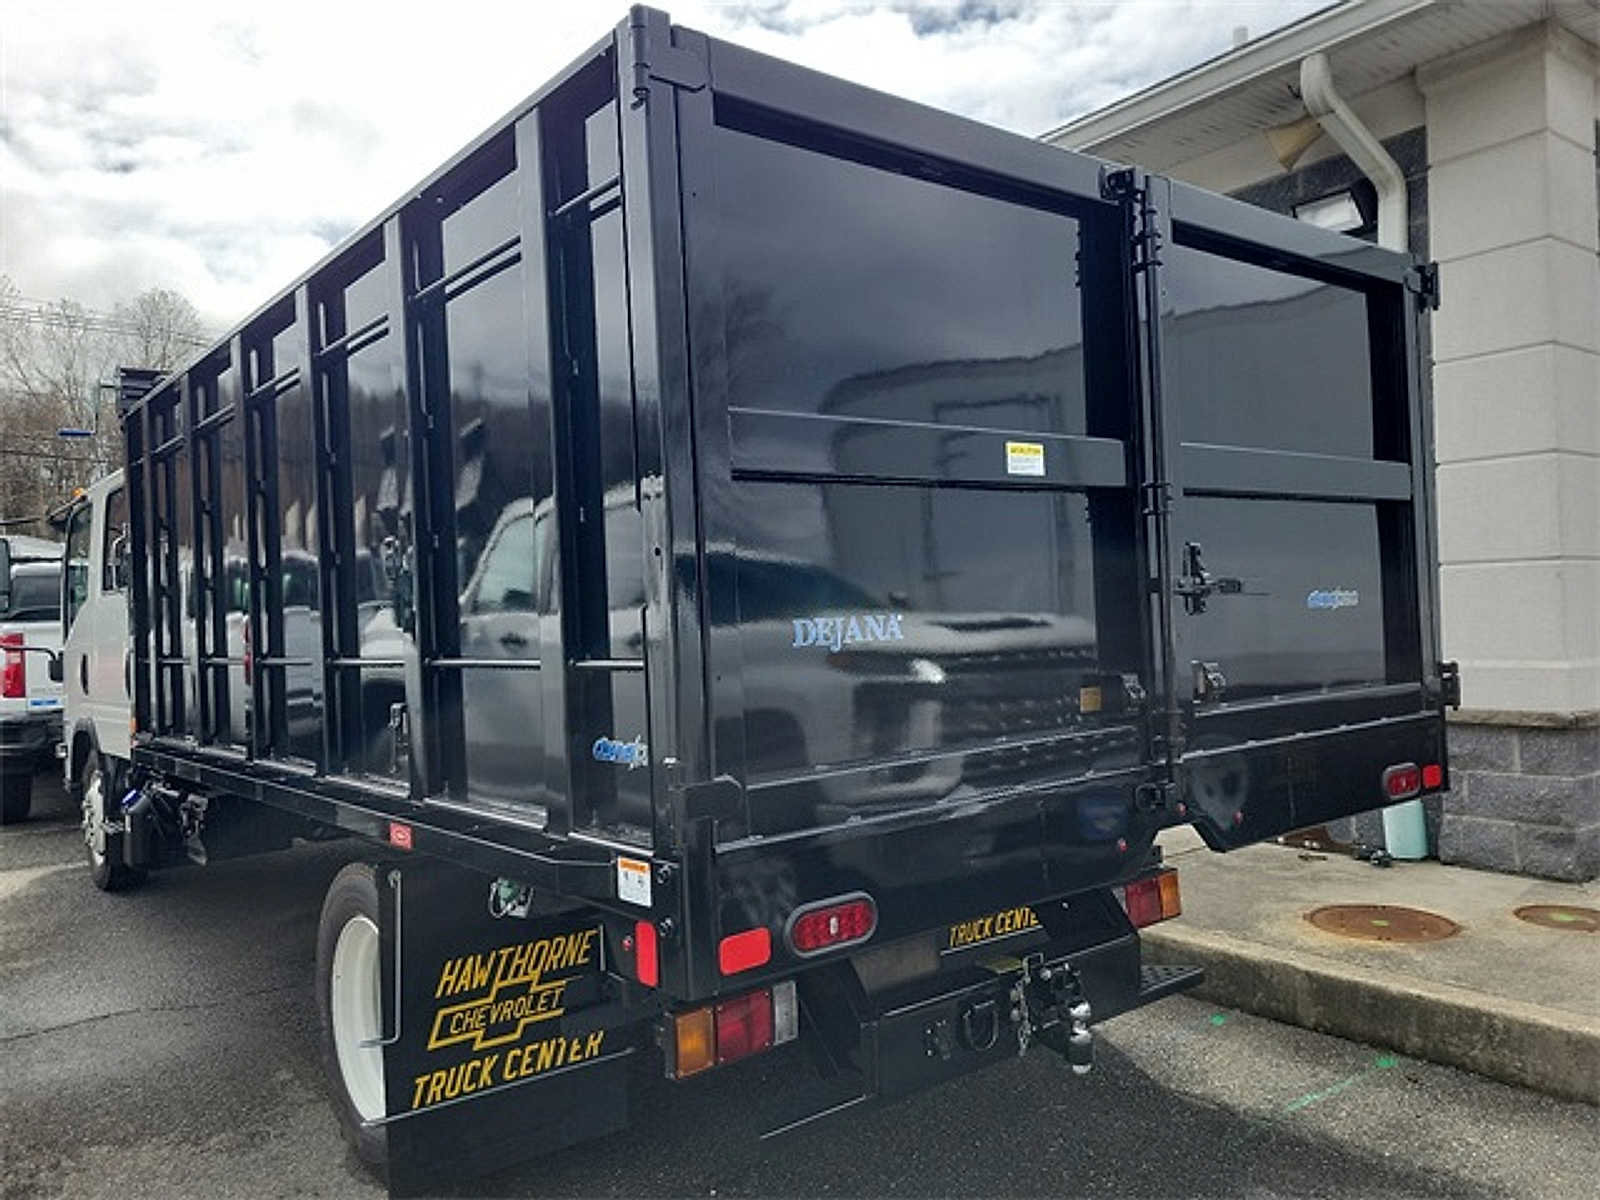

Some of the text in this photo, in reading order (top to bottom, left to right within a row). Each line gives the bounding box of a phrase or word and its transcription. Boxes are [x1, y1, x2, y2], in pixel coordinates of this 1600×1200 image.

[792, 613, 903, 652] DEJANA
[950, 917, 994, 948] TRUCK
[434, 929, 598, 999] HAWTHORNE
[450, 987, 564, 1034] CHEVROLET
[412, 1030, 604, 1109] TRUCK CENTER
